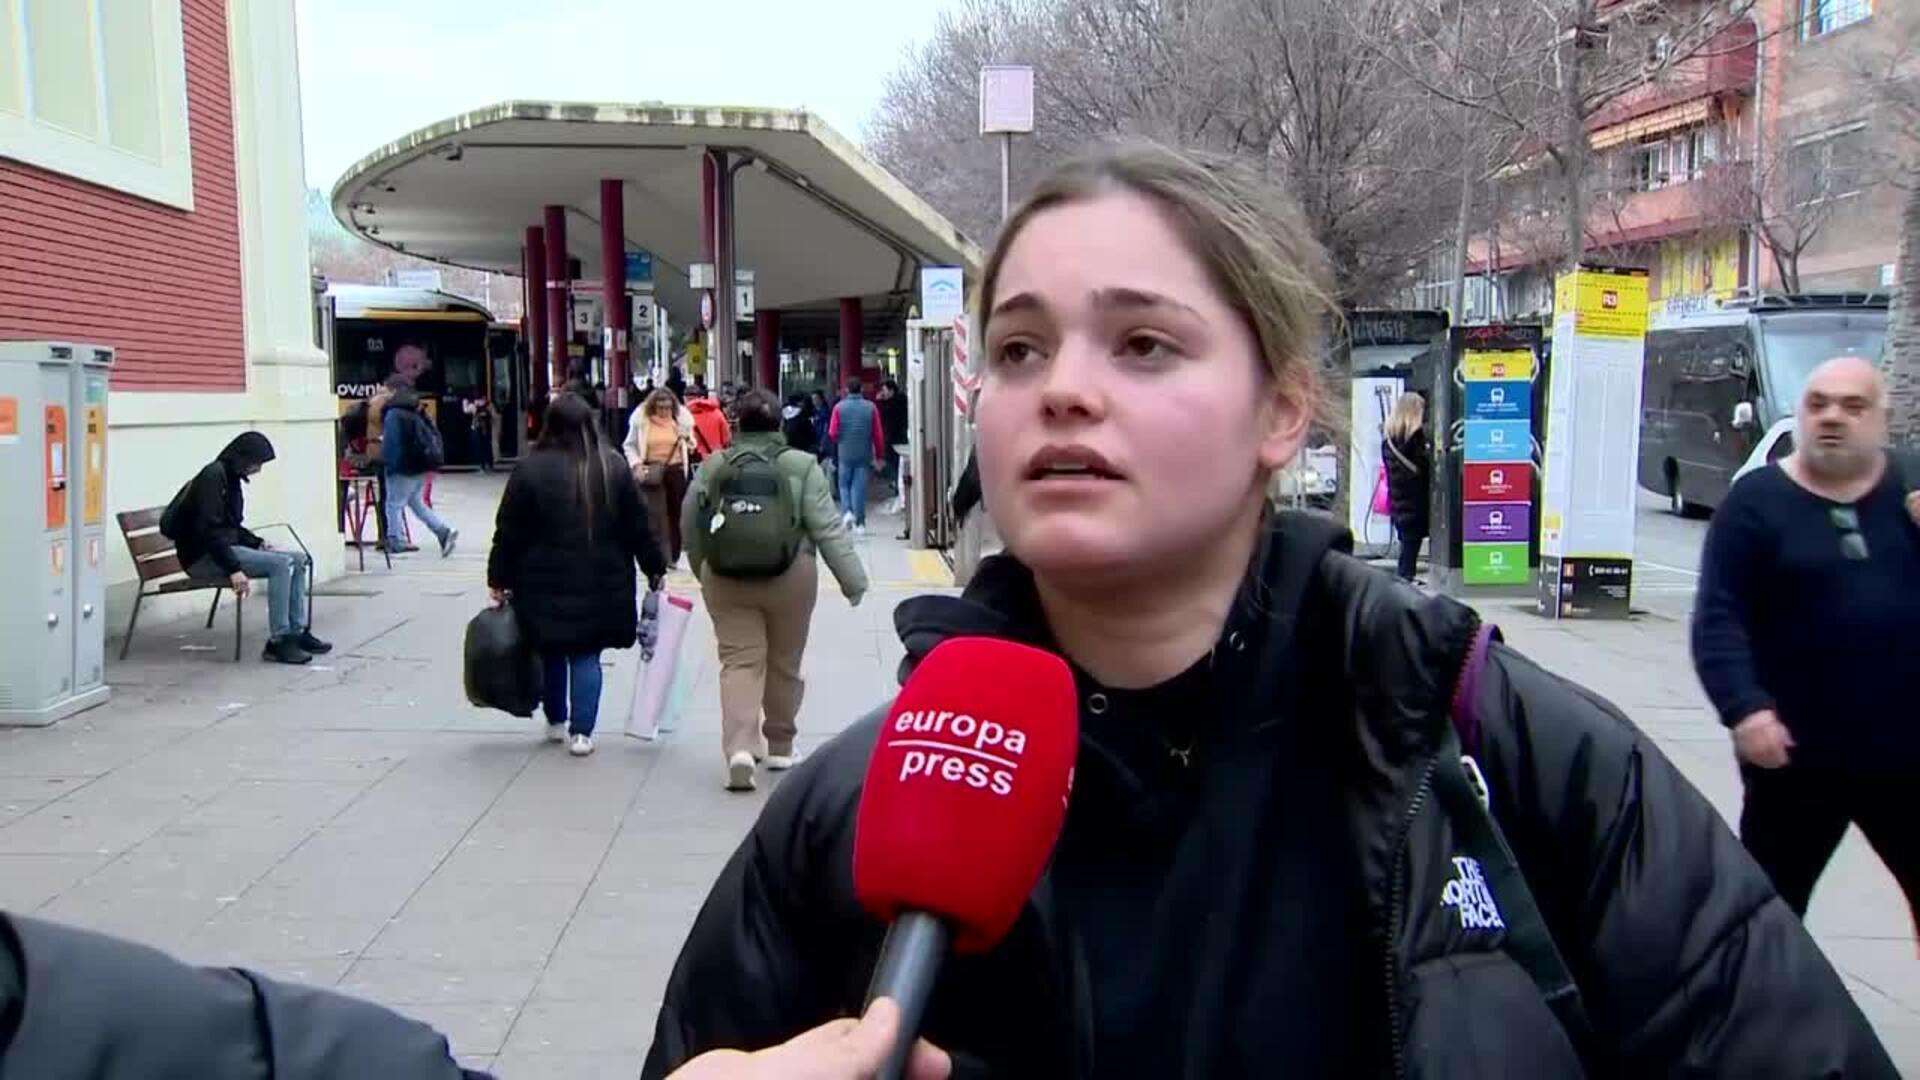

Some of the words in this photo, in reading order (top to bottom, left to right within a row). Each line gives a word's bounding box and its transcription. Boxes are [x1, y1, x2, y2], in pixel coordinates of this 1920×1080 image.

[742, 292, 748, 307] 1
[580, 312, 588, 324] 3
[639, 304, 649, 318] 2
[896, 710, 1027, 753] europa
[899, 752, 1013, 795] press
[1452, 857, 1484, 880] THE
